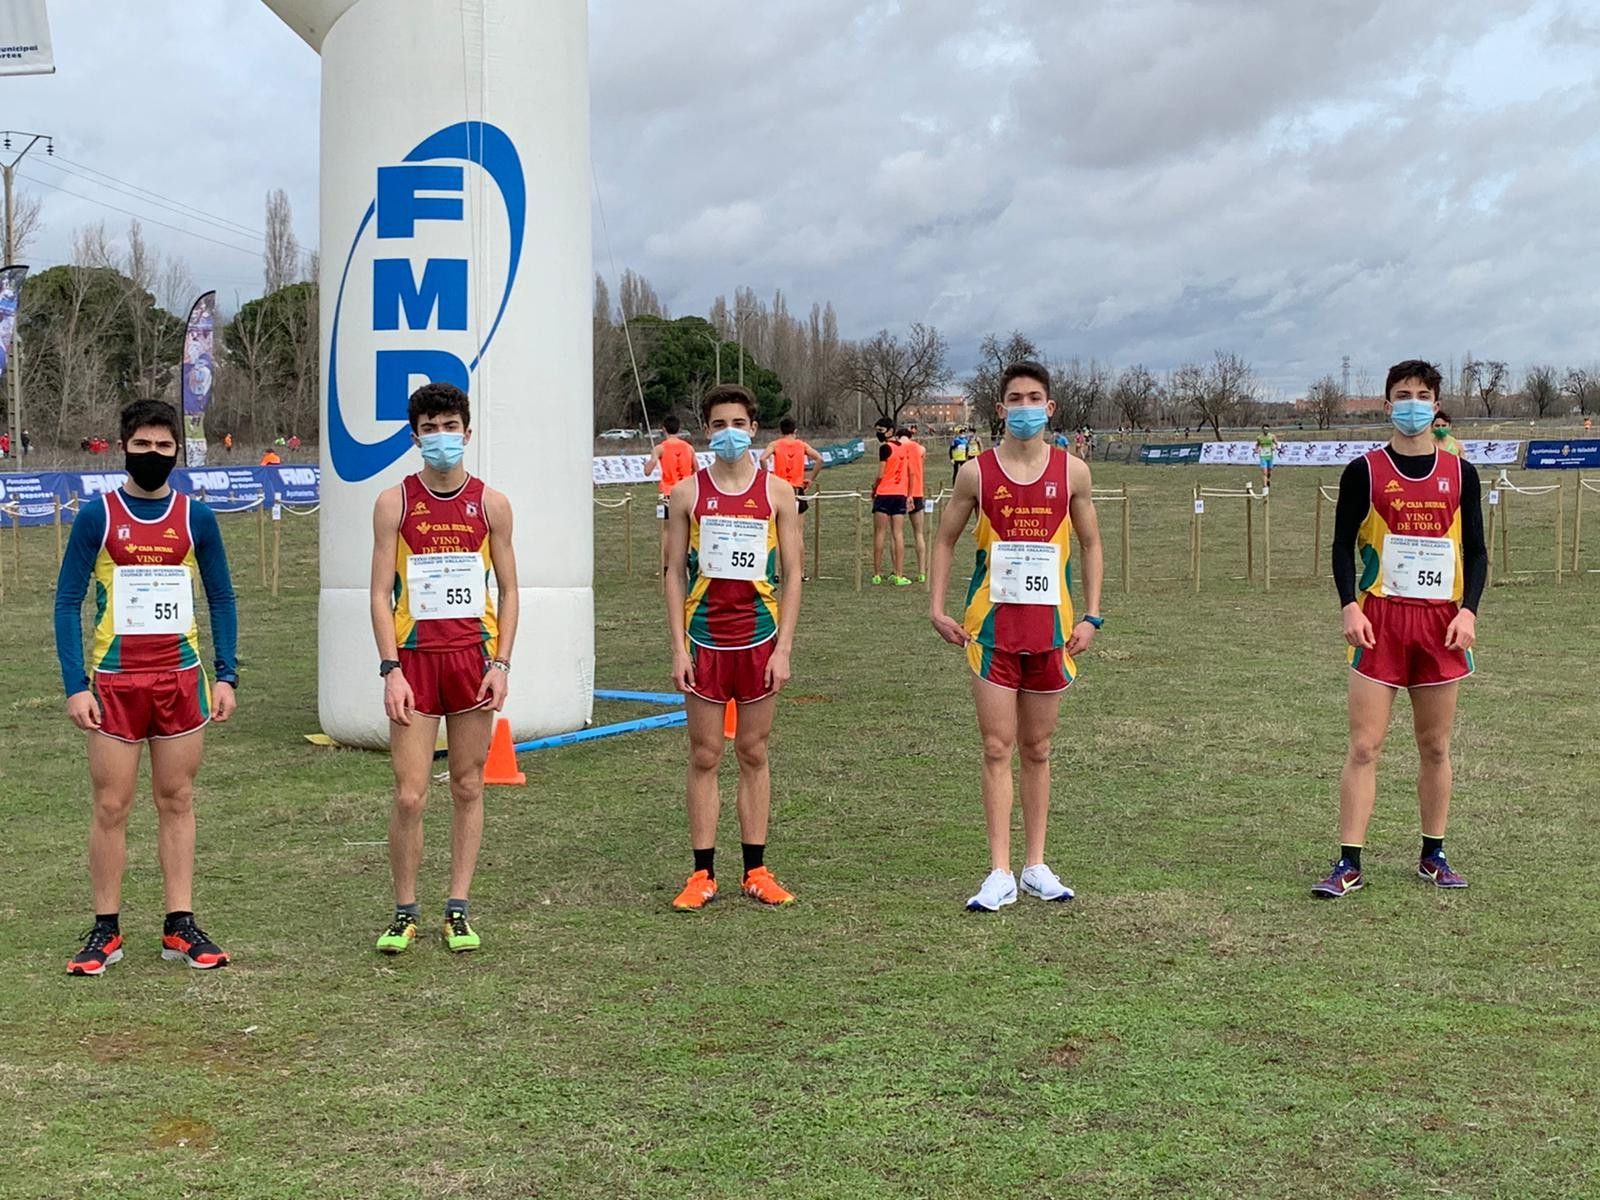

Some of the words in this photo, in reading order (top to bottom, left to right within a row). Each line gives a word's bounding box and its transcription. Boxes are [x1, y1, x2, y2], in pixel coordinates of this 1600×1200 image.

[188, 471, 230, 490] FMD
[278, 468, 316, 485] FMD
[1013, 519, 1040, 528] VINO
[1405, 512, 1434, 521] VINO
[1019, 528, 1049, 537] TORO
[1397, 522, 1411, 531] DE
[1412, 522, 1442, 531] TORO
[431, 535, 461, 545] VINO
[136, 555, 163, 563] VINO
[731, 551, 755, 568] 552
[1025, 575, 1049, 592] 550
[1417, 570, 1442, 587] 554
[446, 587, 472, 605] 553
[154, 602, 179, 620] 551
